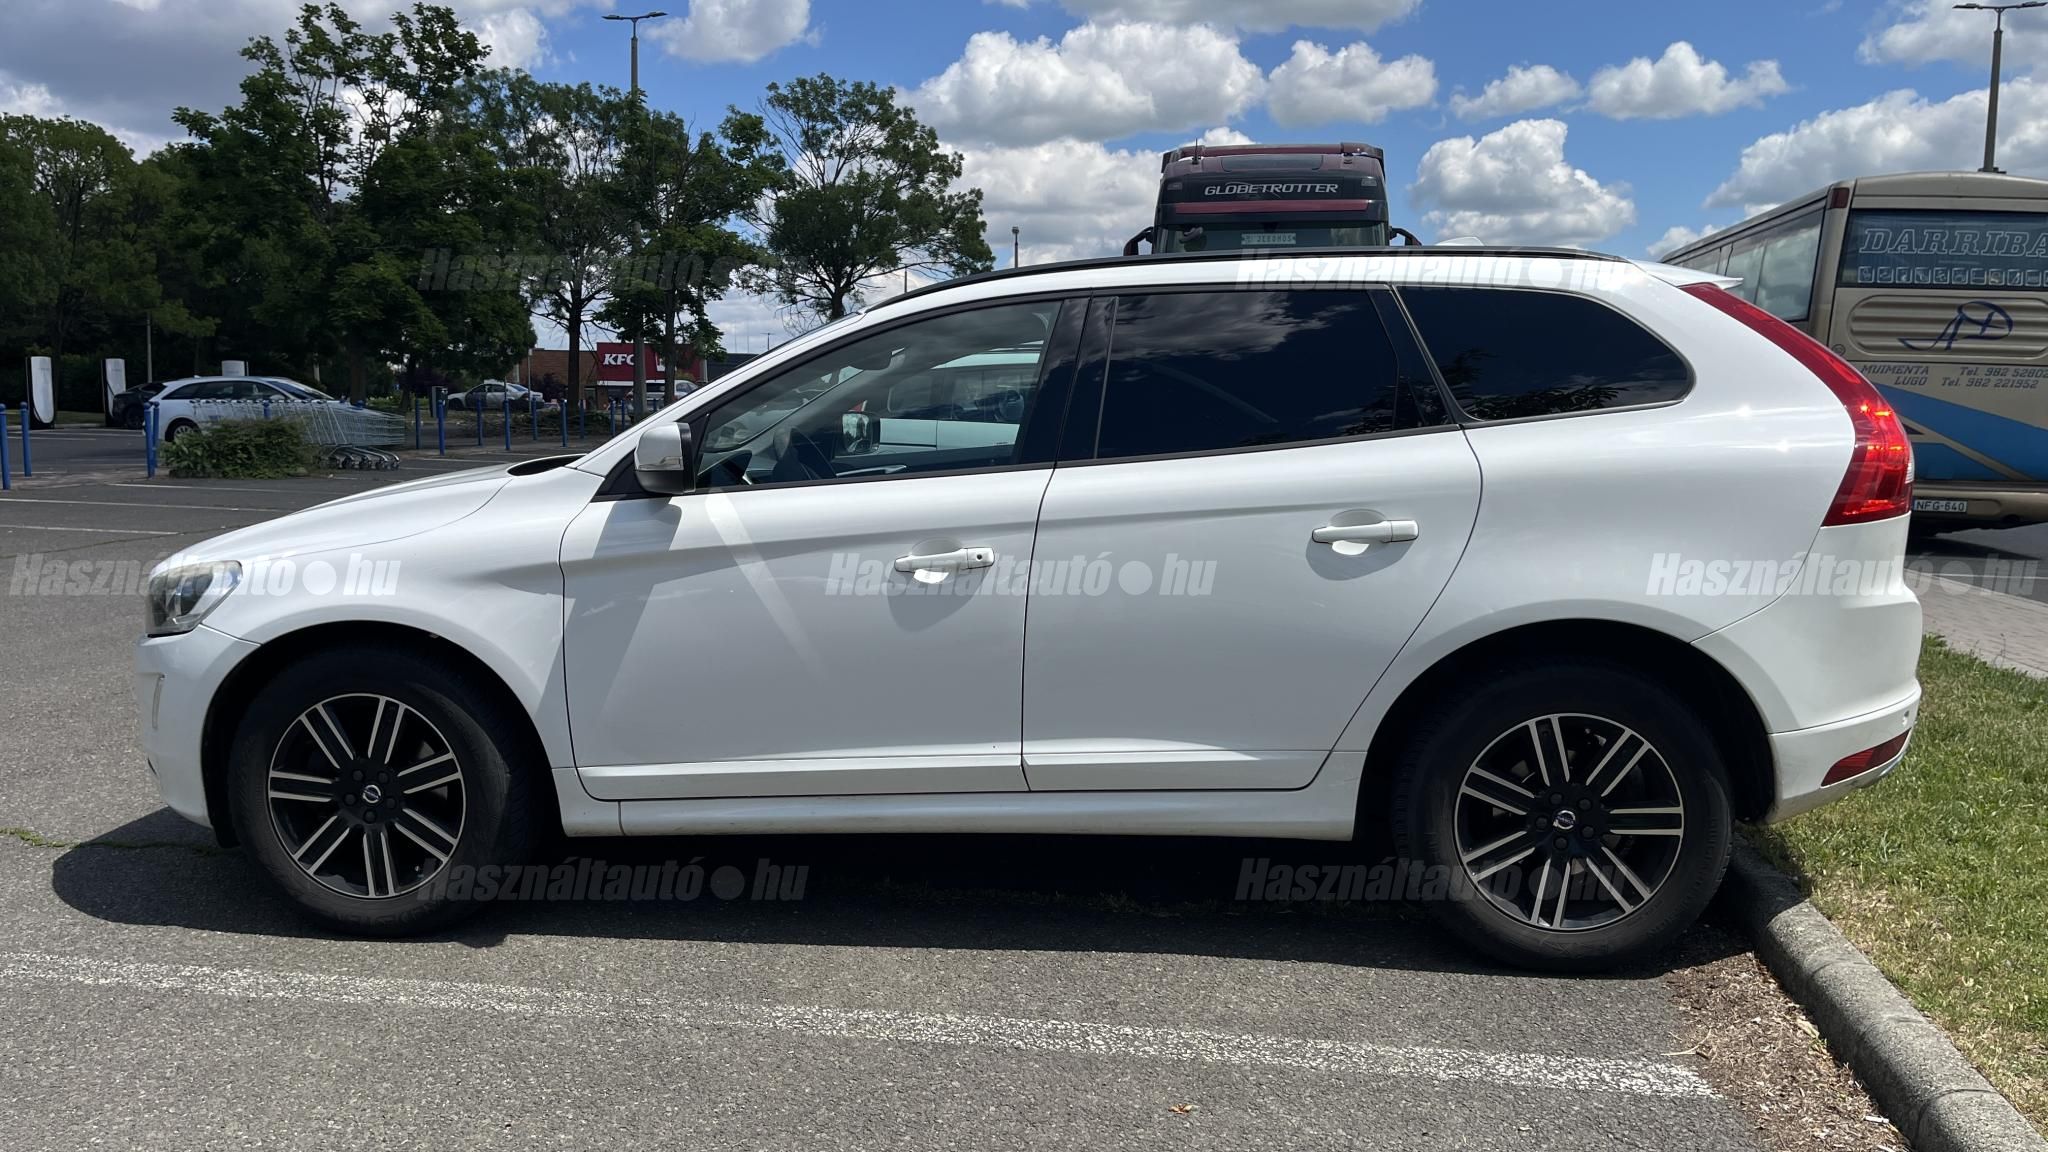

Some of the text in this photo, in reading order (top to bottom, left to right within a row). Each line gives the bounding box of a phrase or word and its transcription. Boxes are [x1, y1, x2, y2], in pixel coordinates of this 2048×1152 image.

[1204, 183, 1339, 196] GLOBETROTTER
[1859, 228, 2048, 258] DARRIBA
[603, 353, 635, 366] KFC
[1861, 364, 1930, 375] MUIMENTA
[1984, 367, 2008, 378] 982
[1894, 376, 1929, 386] LUGO
[1966, 377, 1991, 388] 982
